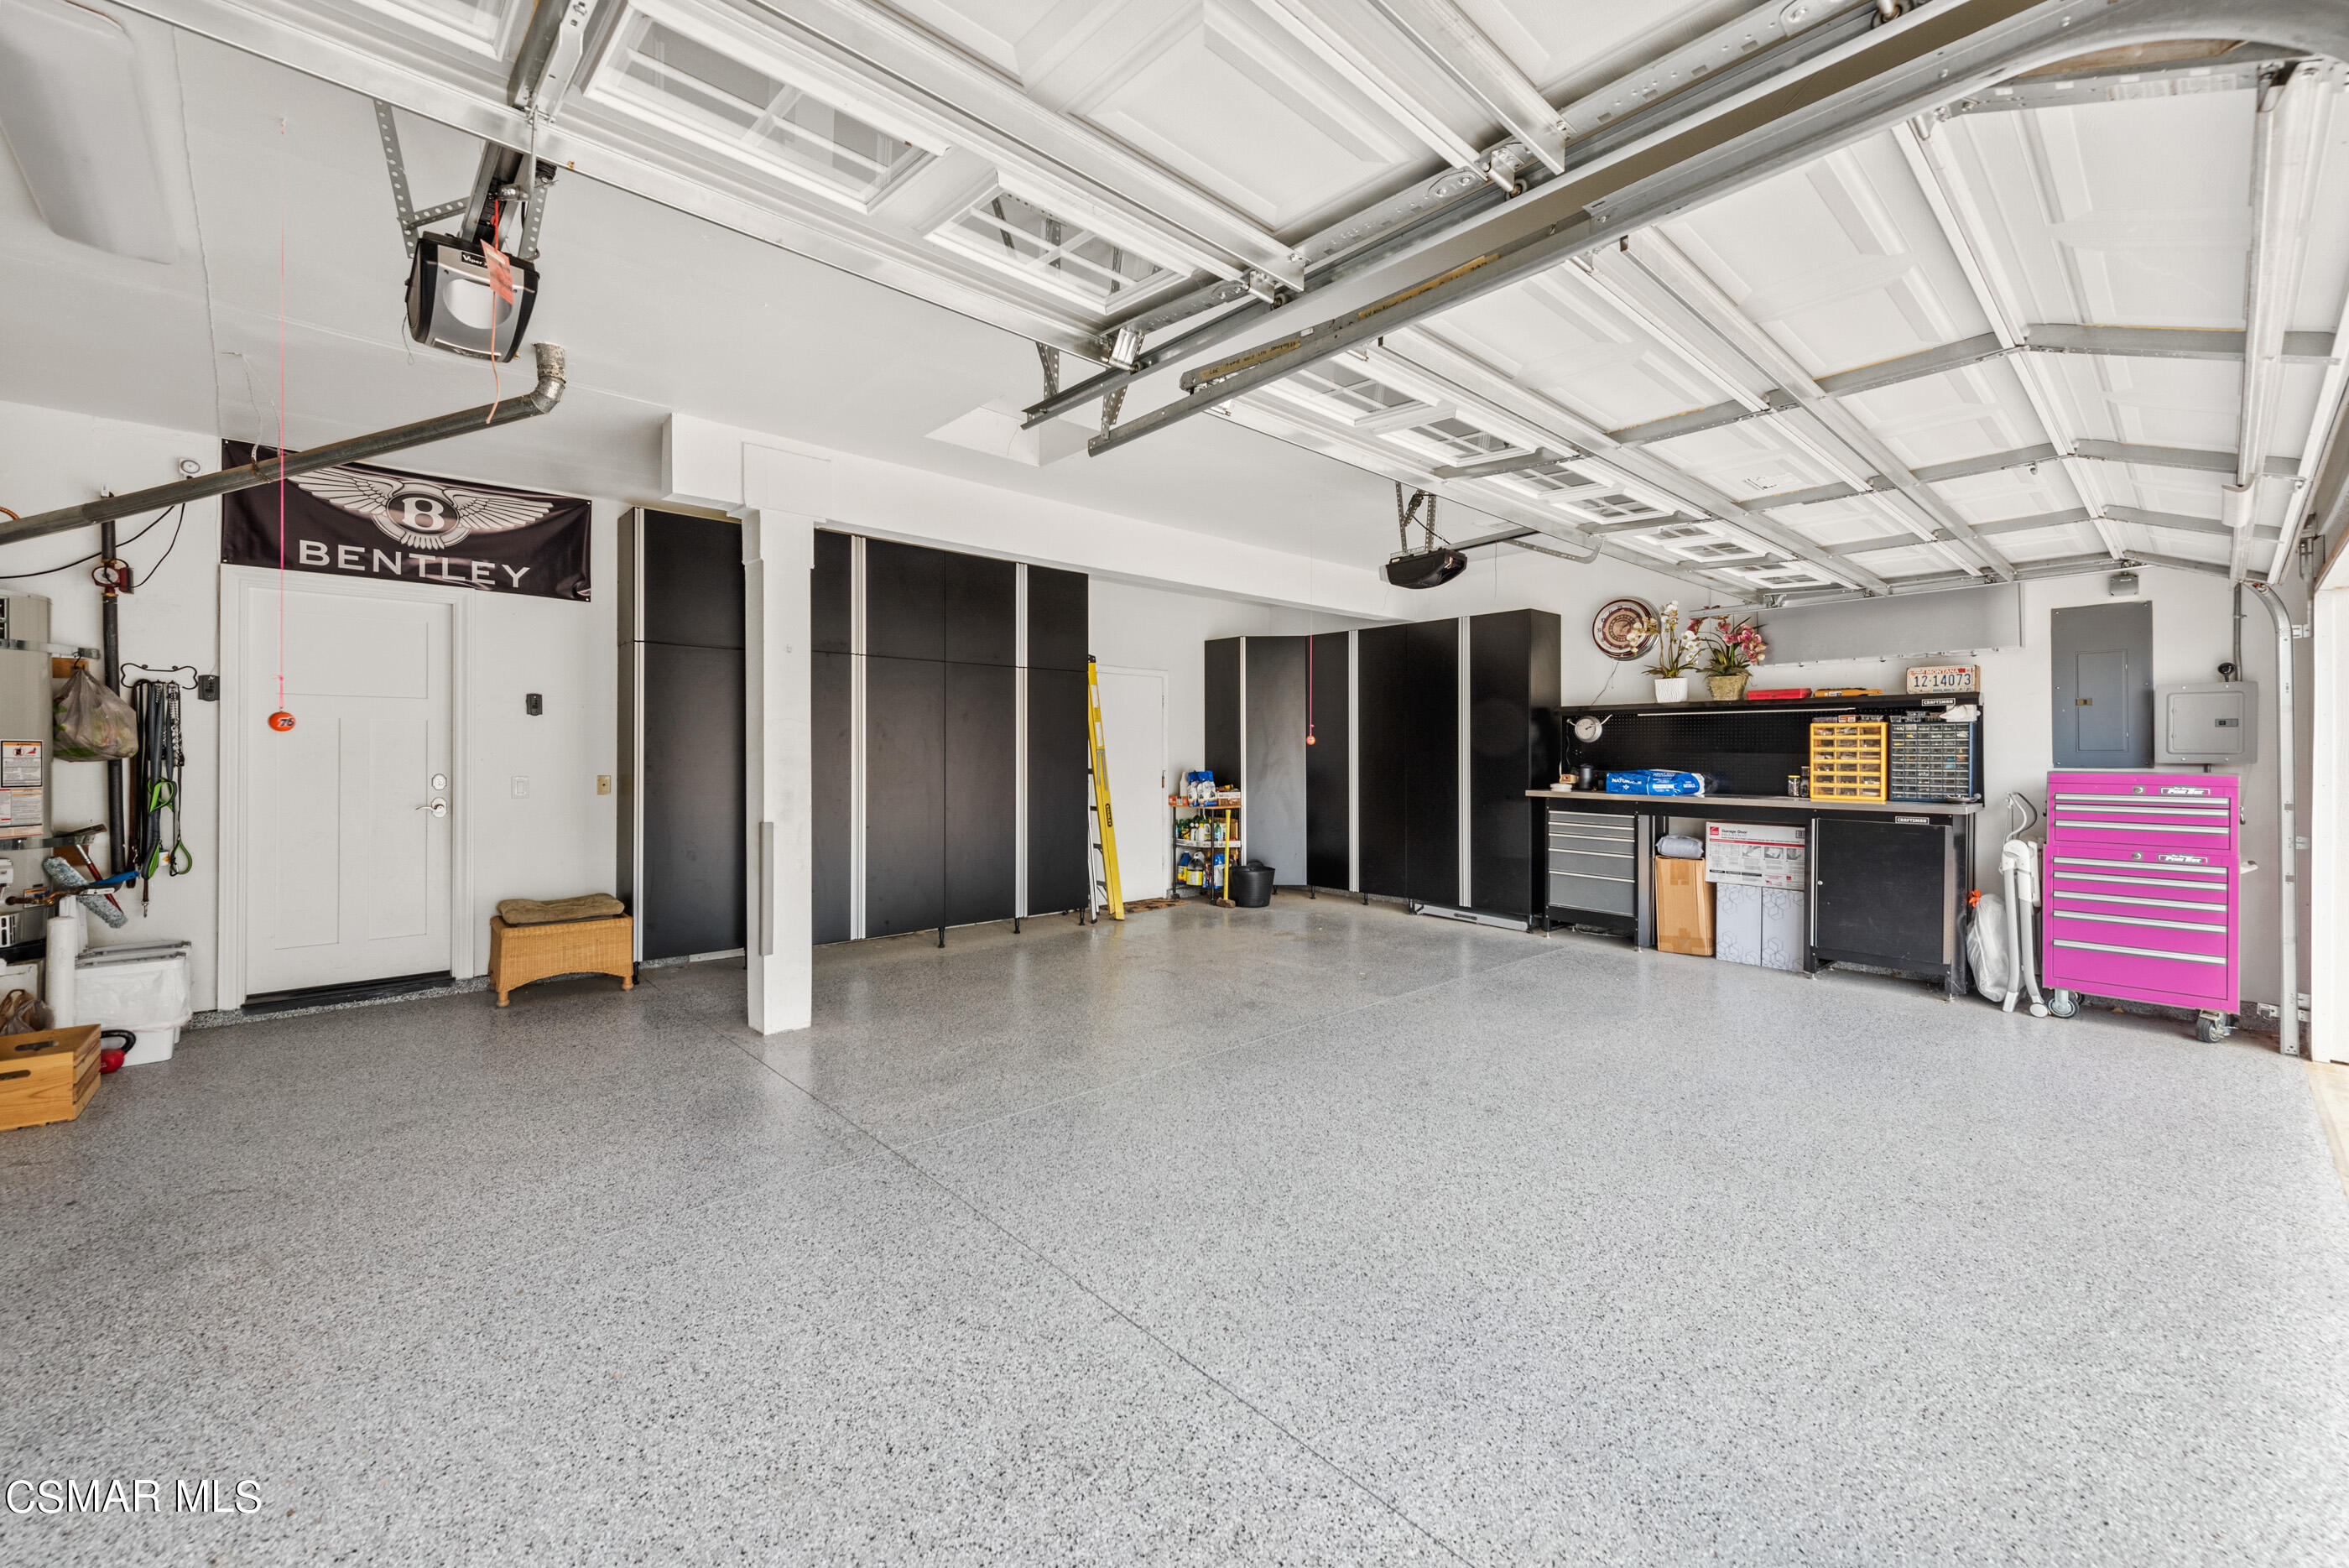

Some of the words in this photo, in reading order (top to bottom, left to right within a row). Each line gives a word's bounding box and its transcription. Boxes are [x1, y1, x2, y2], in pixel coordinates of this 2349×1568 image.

[462, 254, 483, 265] Viper
[401, 497, 446, 532] B
[299, 539, 531, 588] BENTLEY
[279, 717, 294, 727] 76
